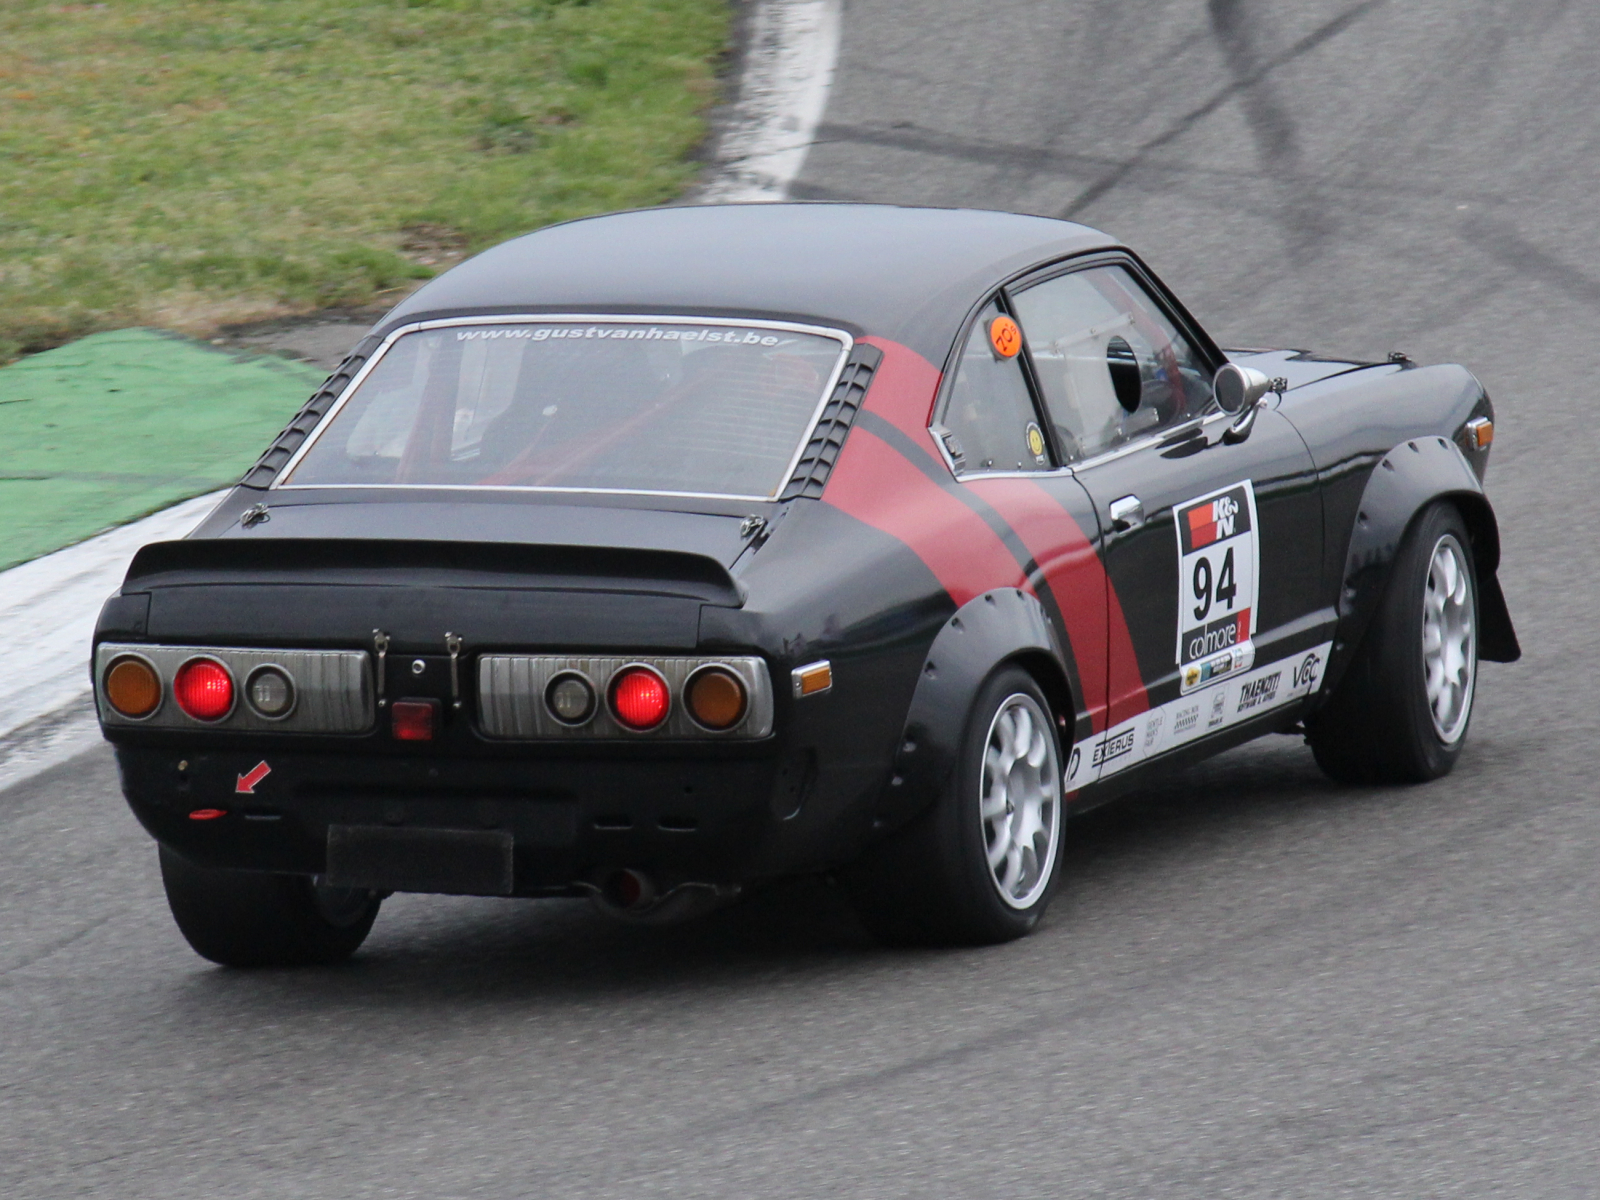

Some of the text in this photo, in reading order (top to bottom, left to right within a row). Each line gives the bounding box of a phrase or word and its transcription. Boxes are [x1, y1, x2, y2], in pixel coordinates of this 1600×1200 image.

[457, 326, 778, 346] www.gustvanhaelst.be
[995, 323, 1018, 352] 70's
[1193, 546, 1237, 621] 94
[1189, 623, 1236, 660] colmore
